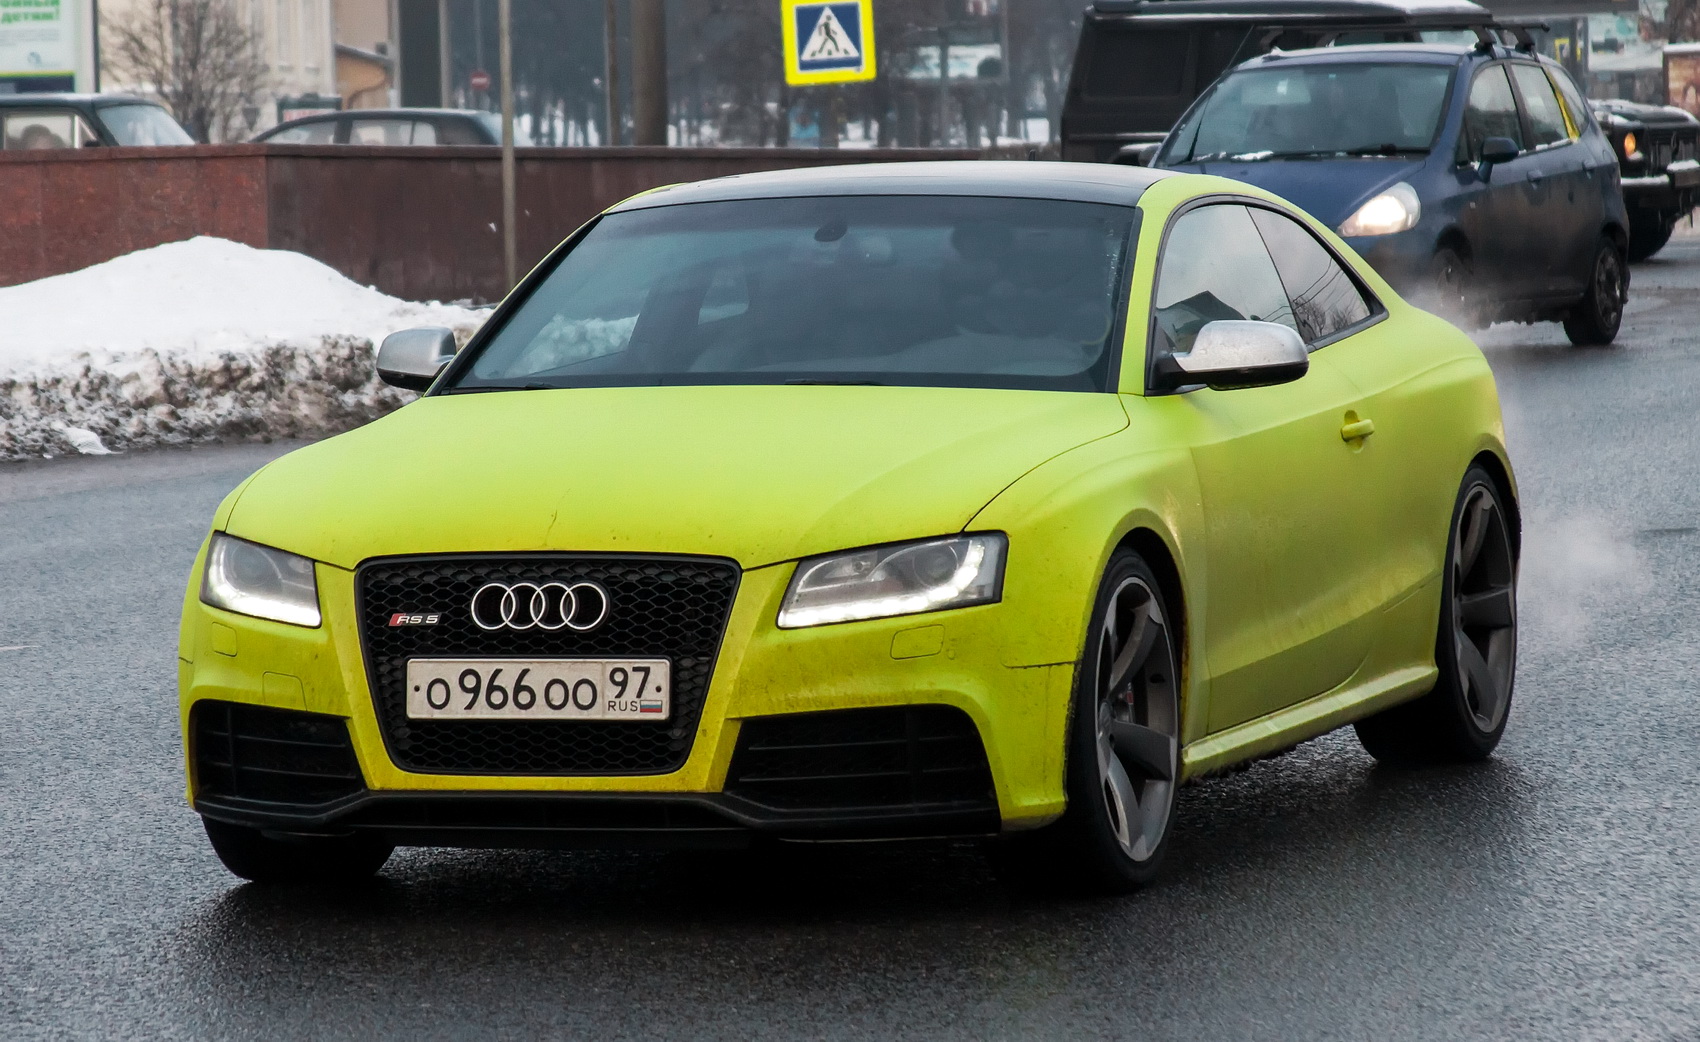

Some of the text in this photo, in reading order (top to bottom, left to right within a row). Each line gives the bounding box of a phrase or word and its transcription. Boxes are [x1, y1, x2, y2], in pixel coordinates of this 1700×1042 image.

[396, 615, 439, 624] RS 5
[608, 667, 652, 699] 97
[607, 700, 638, 712] RUS
